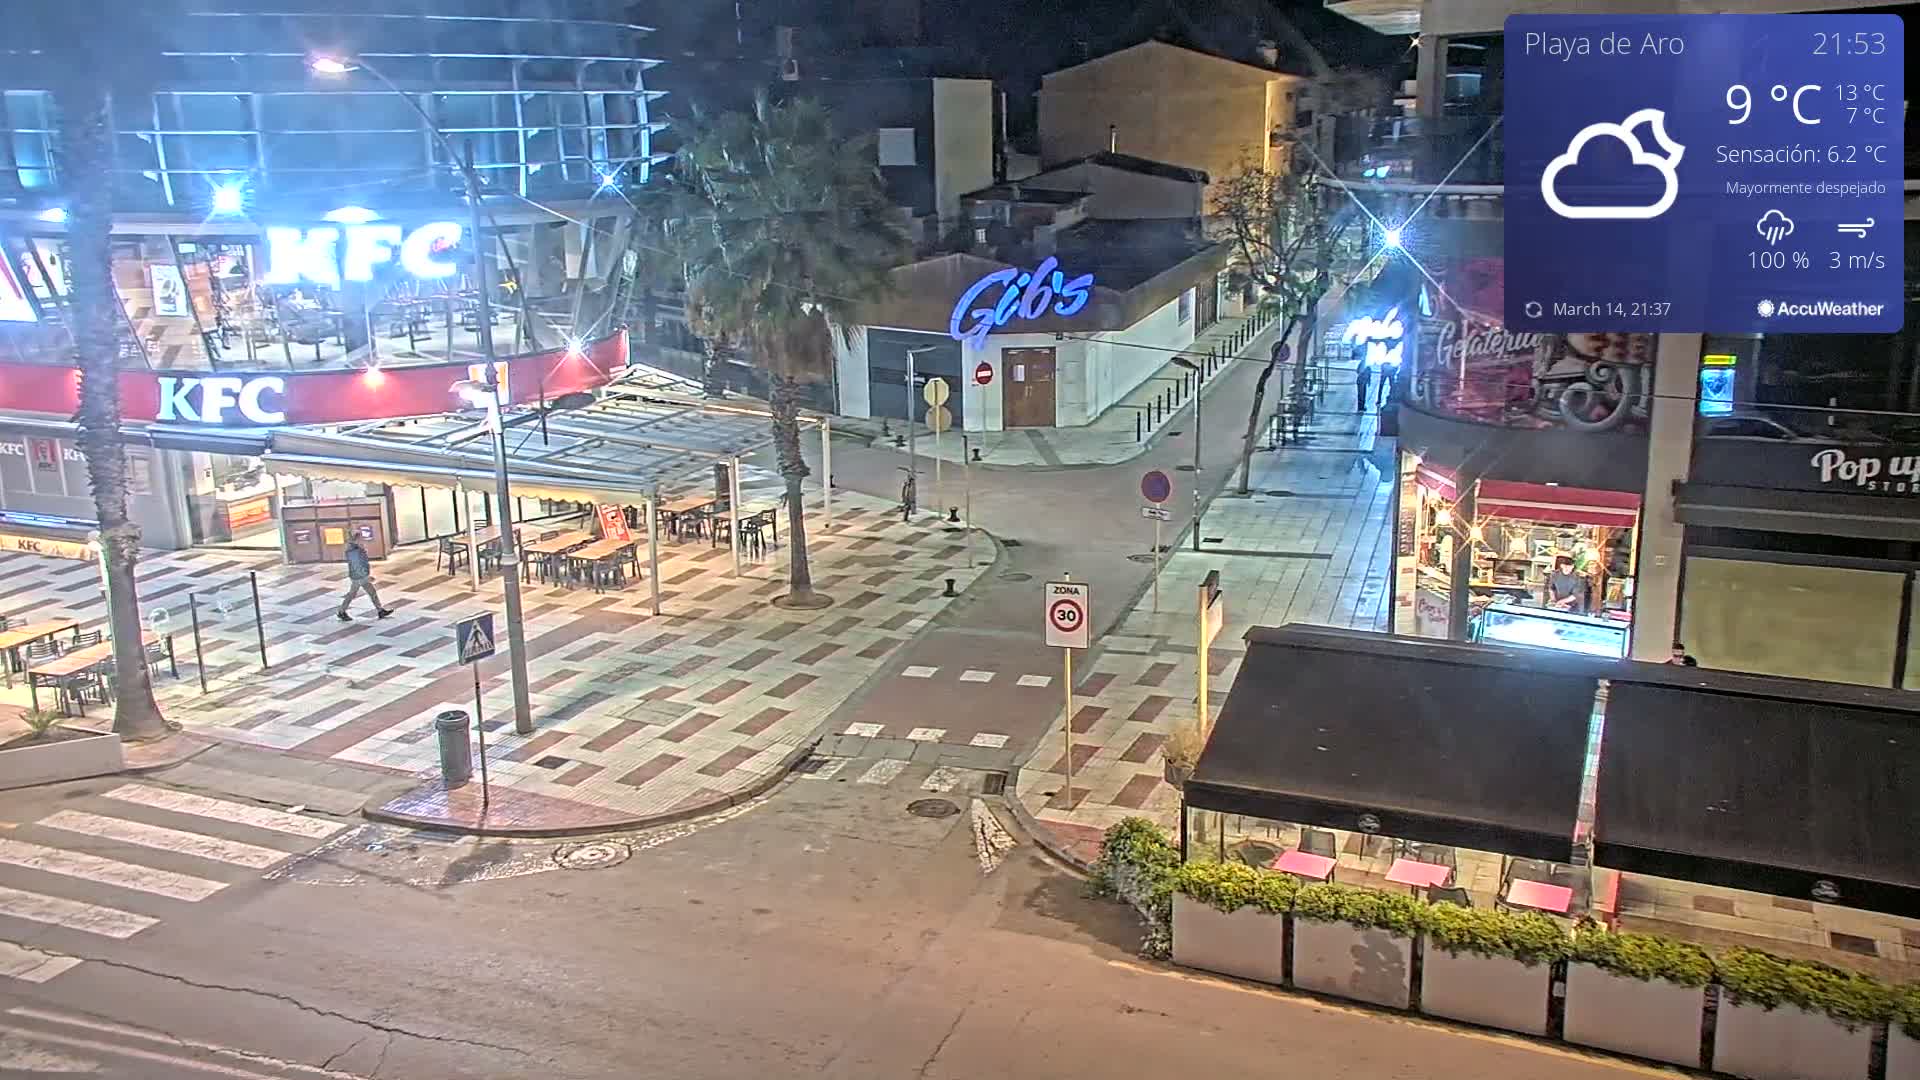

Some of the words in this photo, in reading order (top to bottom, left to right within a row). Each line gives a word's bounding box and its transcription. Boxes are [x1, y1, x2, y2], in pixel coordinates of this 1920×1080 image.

[264, 221, 463, 287] KFC
[950, 256, 1094, 350] Gib's
[155, 376, 287, 424] KFC
[0, 442, 25, 456] KFC
[1811, 448, 1881, 487] Pop
[17, 539, 41, 553] KFC
[1053, 586, 1080, 596] ZONA
[1056, 609, 1077, 622] 30
